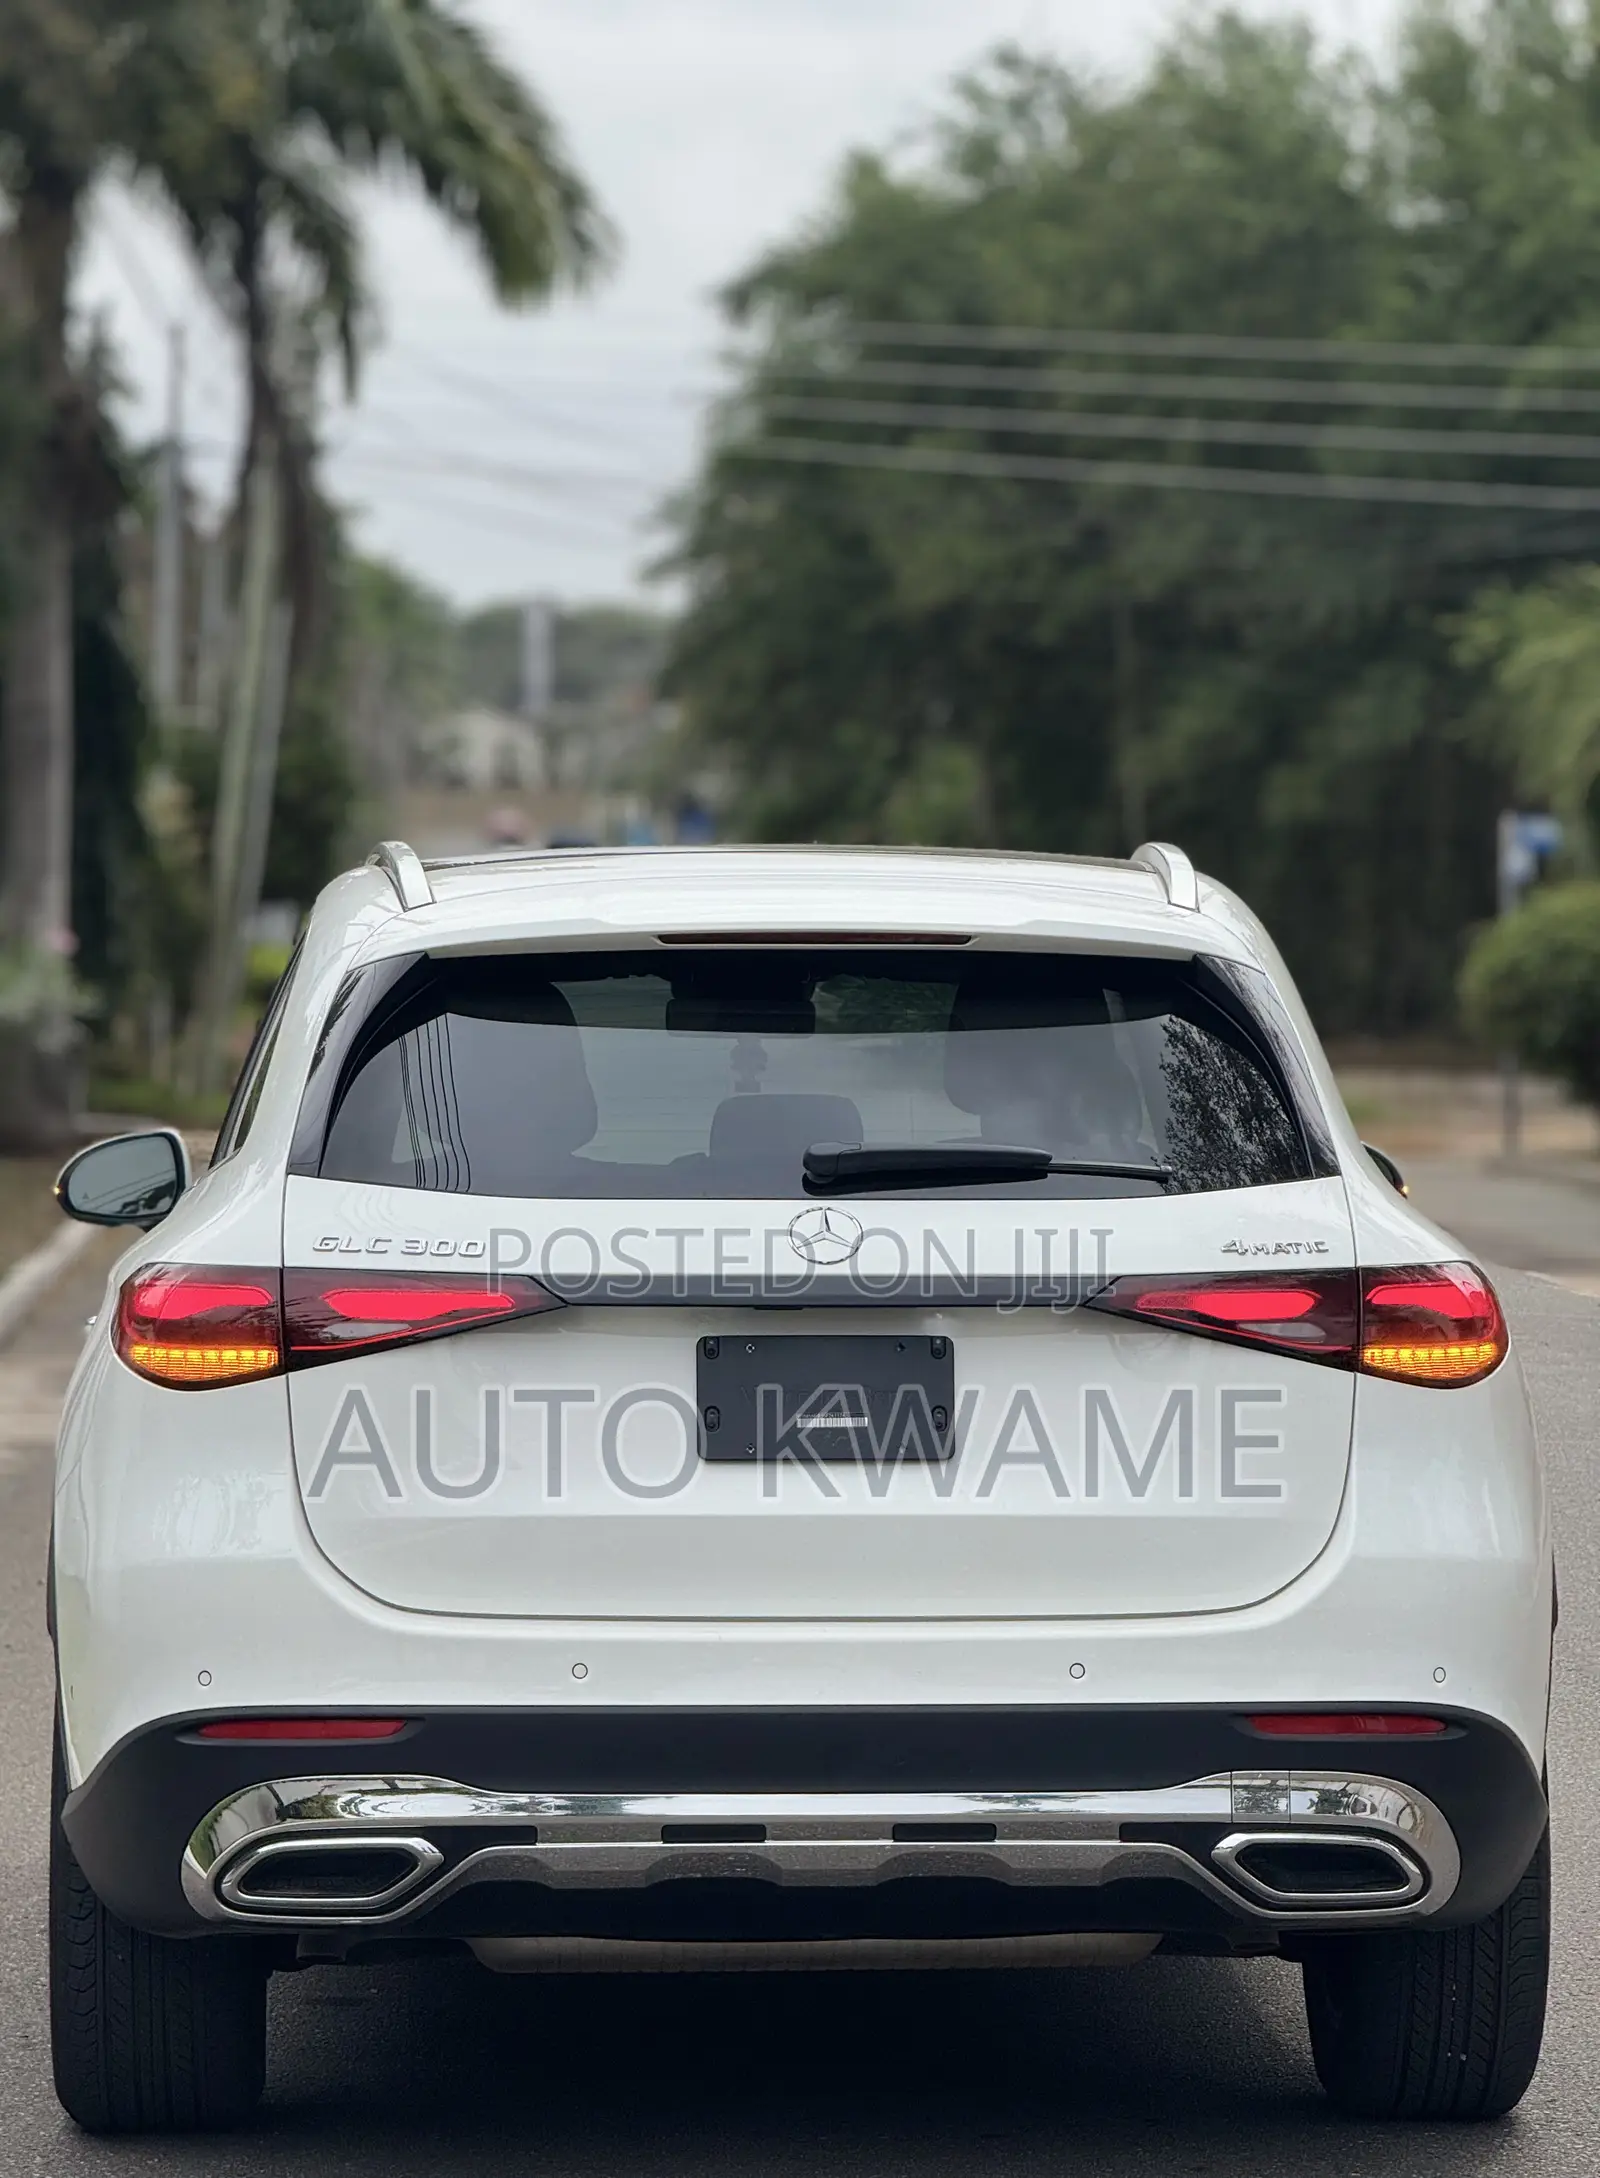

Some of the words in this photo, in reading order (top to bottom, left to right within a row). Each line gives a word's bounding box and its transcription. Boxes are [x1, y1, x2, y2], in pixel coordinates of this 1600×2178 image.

[312, 1235, 391, 1254] GLC
[401, 1238, 486, 1258] 300
[1221, 1238, 1330, 1256] 4MATIC
